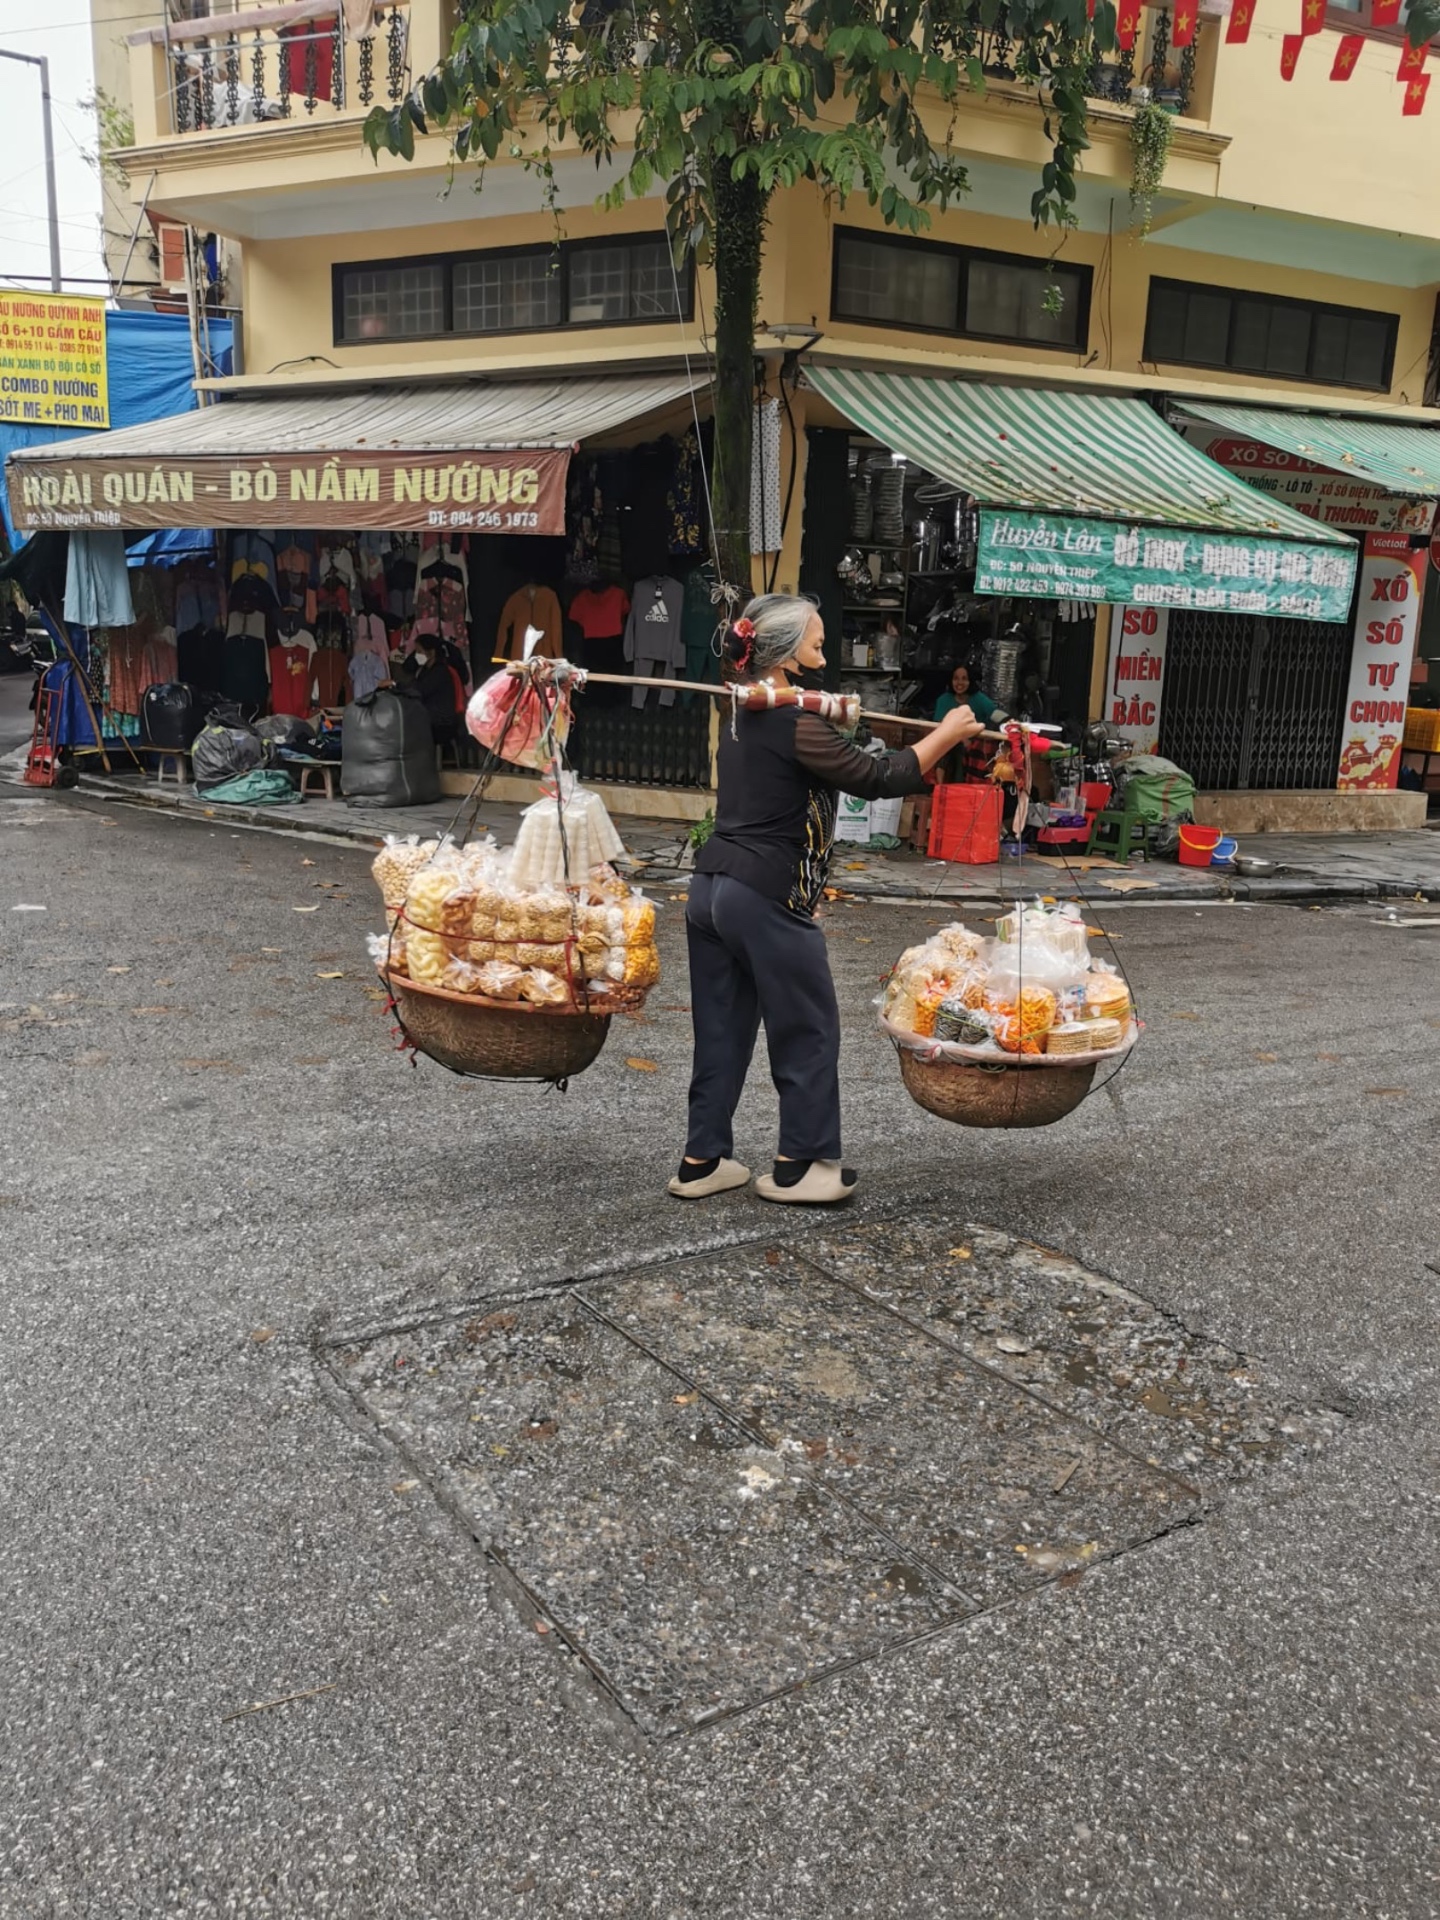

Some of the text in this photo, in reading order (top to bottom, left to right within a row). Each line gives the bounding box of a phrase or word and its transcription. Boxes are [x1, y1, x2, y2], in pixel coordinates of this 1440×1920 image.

[82, 307, 102, 323] ANH
[13, 324, 44, 338] 6+10
[17, 358, 41, 372] XANH
[2, 377, 98, 398] COMBO NƯỚNG
[23, 402, 42, 419] ME
[82, 405, 104, 423] MAI
[22, 469, 92, 506] HOÀI
[103, 465, 194, 506] QUÁN
[230, 461, 278, 501] BÒ
[290, 456, 379, 501] NẦM
[394, 461, 539, 504] NƯỚNG
[477, 511, 501, 526] 246
[506, 512, 538, 527] 1973
[989, 518, 1058, 550] Huyền
[1372, 538, 1408, 549] Vietlott
[1143, 537, 1188, 572] INOX
[1371, 570, 1411, 602] XỔ
[1366, 614, 1406, 645] SỐ
[1115, 648, 1163, 681] MIỀN
[1367, 661, 1400, 691] TỰ
[1112, 694, 1156, 726] BẮC
[1350, 700, 1404, 728] CHỌN
